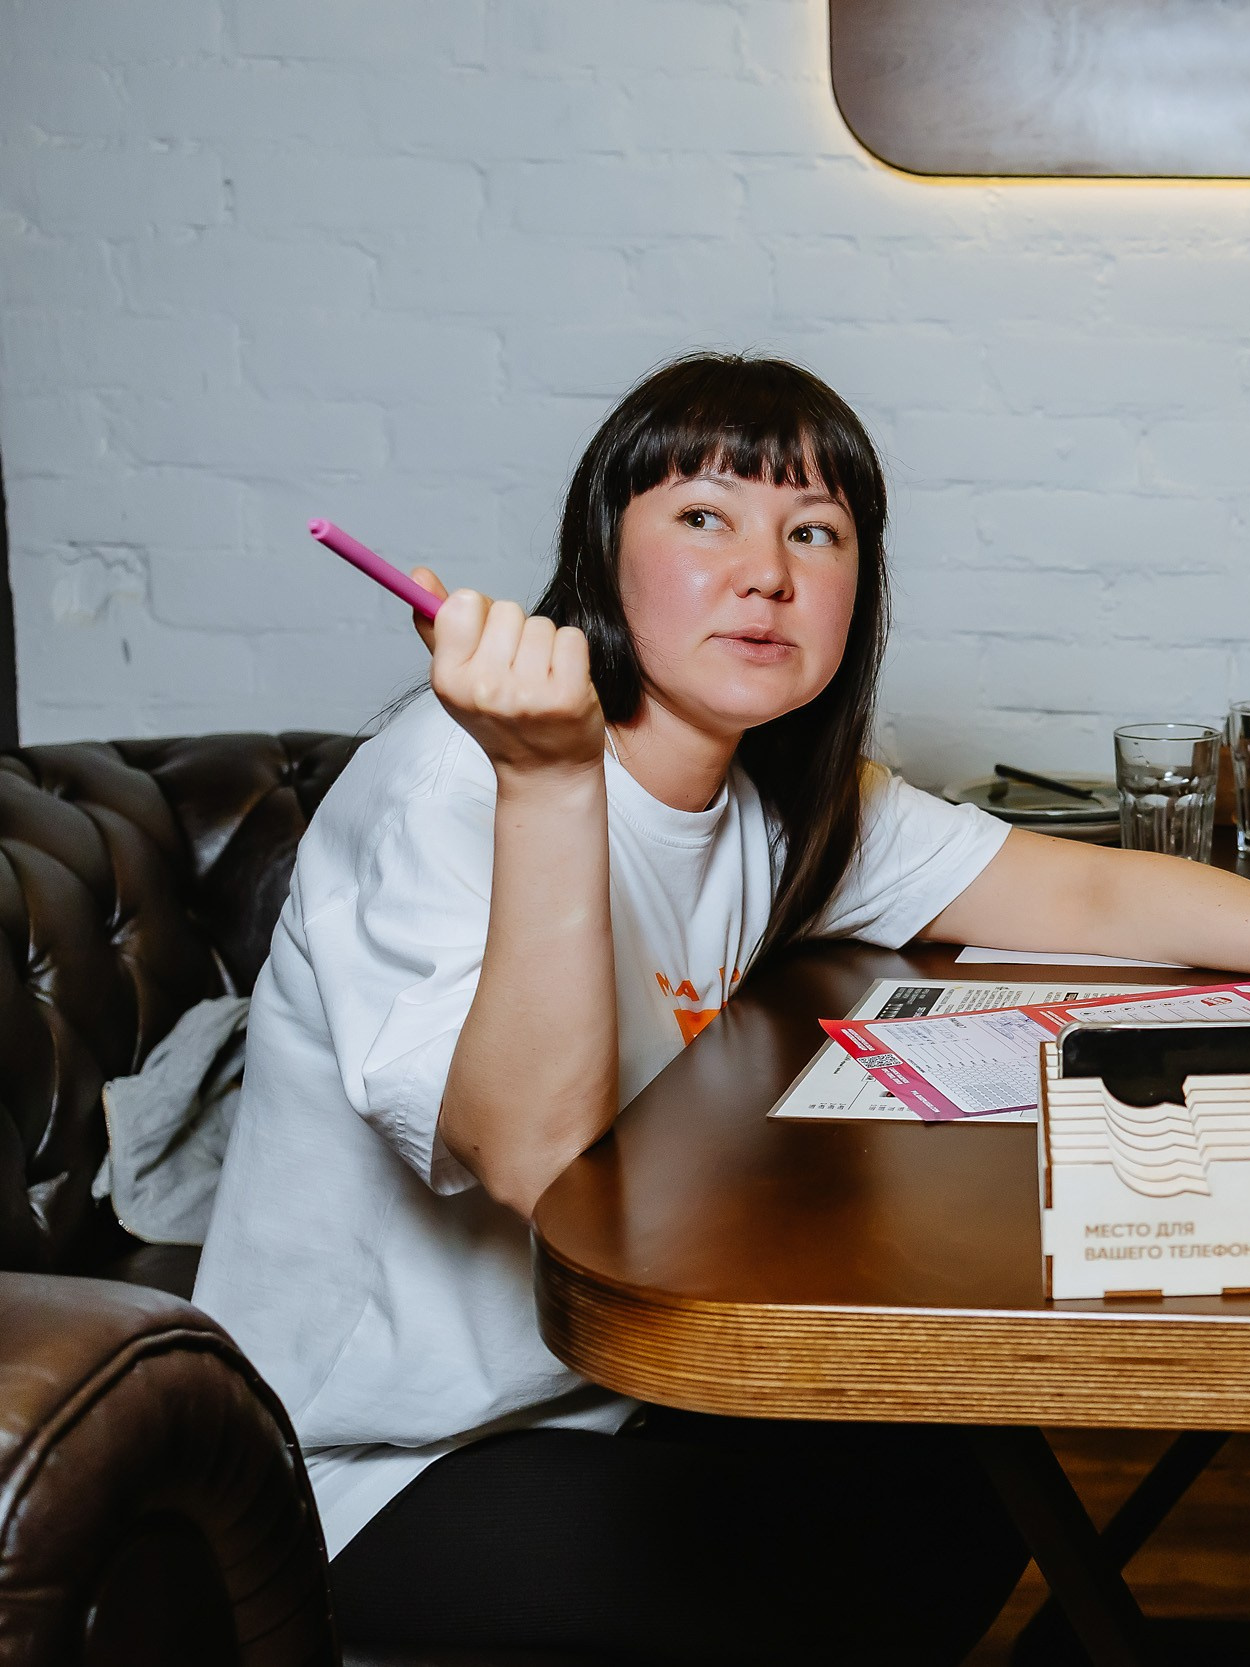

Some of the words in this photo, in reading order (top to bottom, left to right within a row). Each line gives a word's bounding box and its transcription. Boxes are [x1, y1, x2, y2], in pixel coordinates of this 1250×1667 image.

[1084, 1223, 1151, 1239] МЕСТО
[1155, 1221, 1195, 1238] ДЛЯ
[1084, 1245, 1163, 1261] ВАШЕГО
